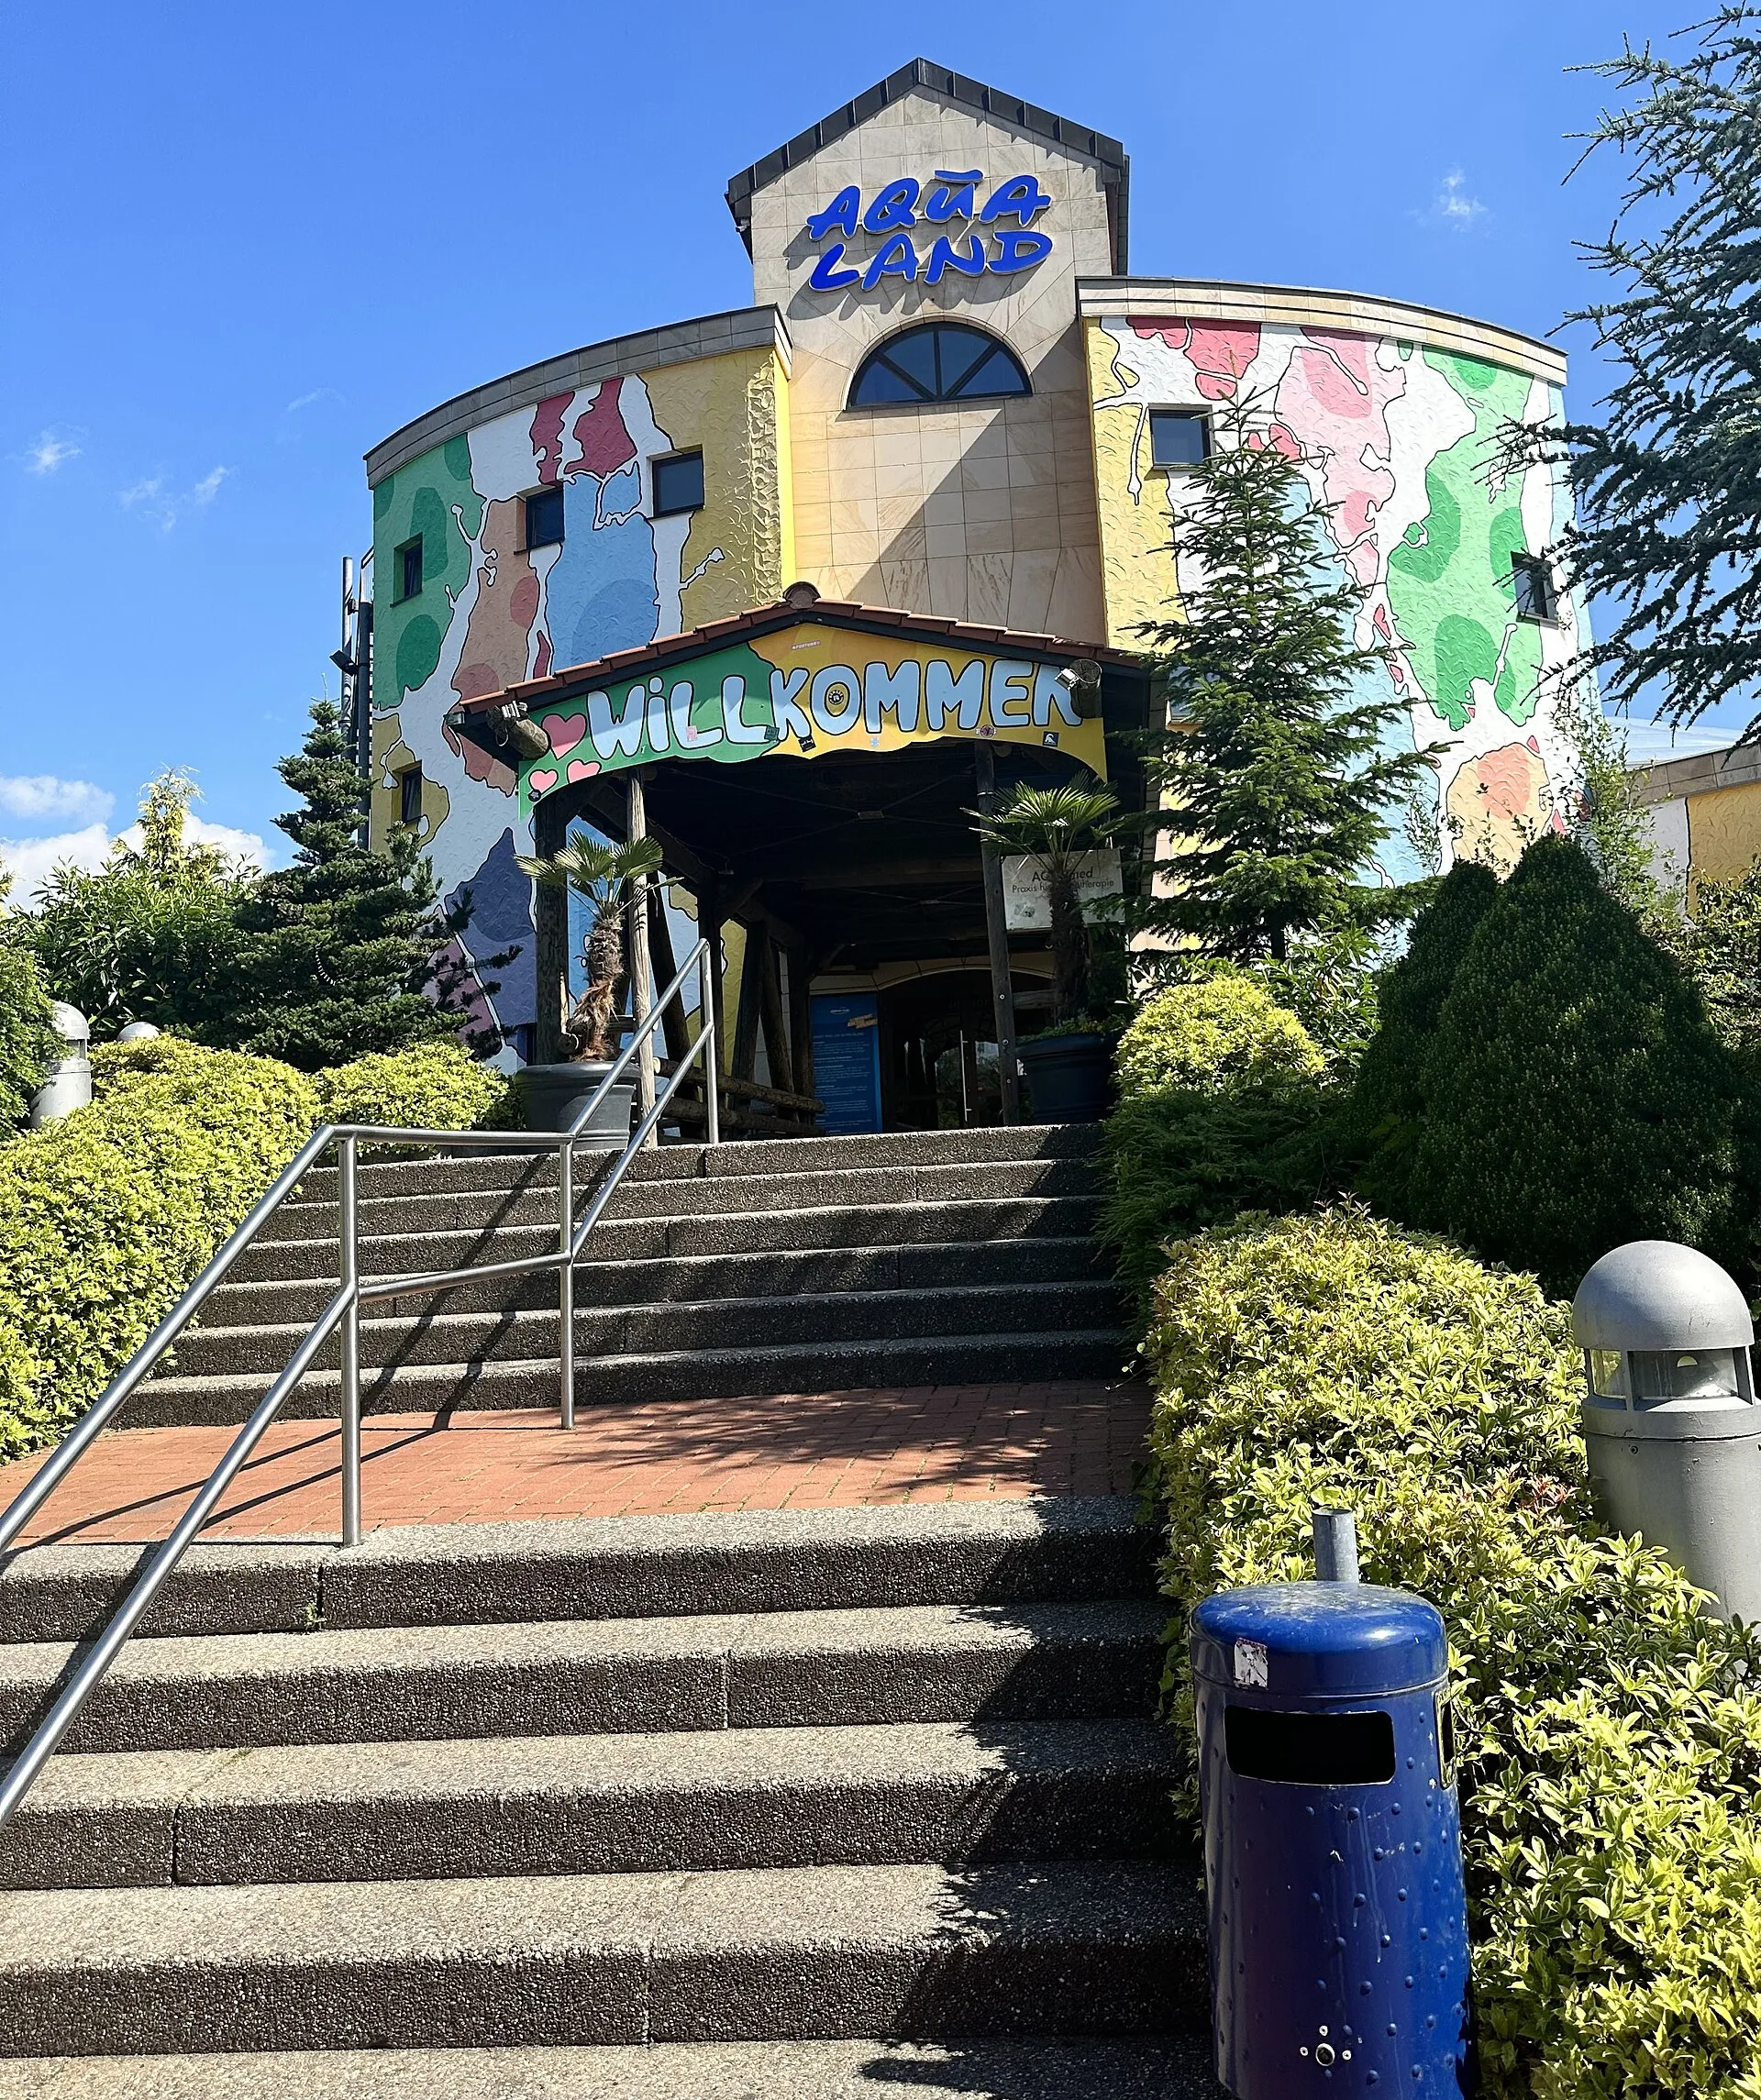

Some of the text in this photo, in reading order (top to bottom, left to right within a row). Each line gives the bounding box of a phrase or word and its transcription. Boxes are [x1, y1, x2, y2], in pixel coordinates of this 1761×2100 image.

[808, 230, 1054, 293] LAND
[1012, 883, 1037, 893] Praxis
[1039, 881, 1052, 891] fü
